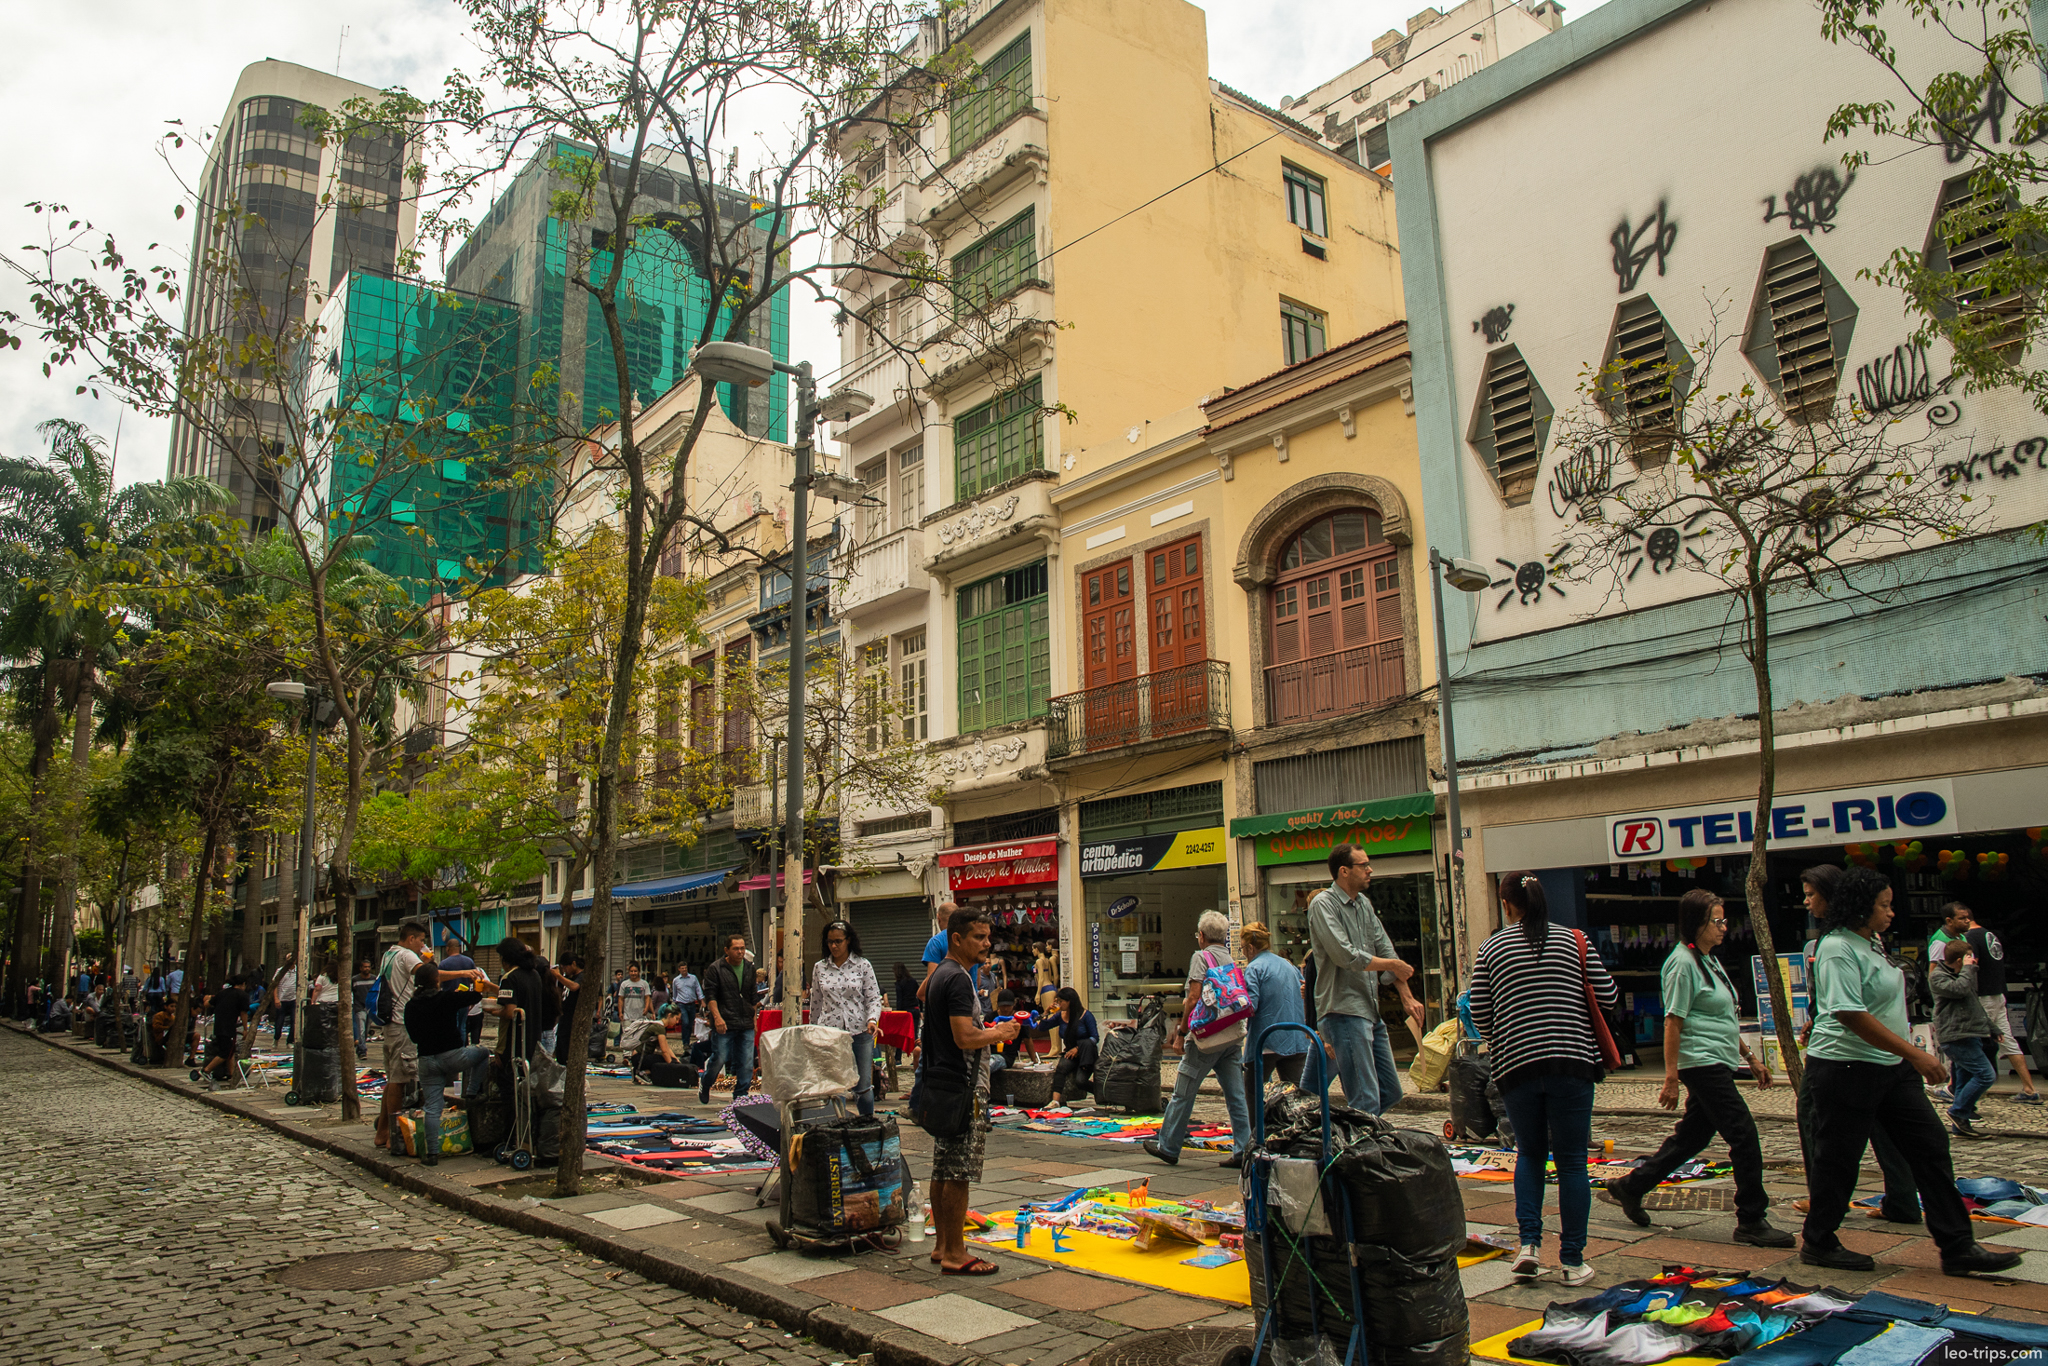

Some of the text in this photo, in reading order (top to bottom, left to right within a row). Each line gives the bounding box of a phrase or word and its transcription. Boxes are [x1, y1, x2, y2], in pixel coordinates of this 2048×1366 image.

[1287, 807, 1366, 828] quality shoes
[1668, 791, 1947, 849] TELE-RIO
[1185, 842, 1215, 855] 2242-4257
[1270, 821, 1413, 857] quality shoes
[964, 848, 1023, 862] Desejo de Mulher
[1083, 844, 1116, 859] centro
[965, 858, 1051, 883] Desejo de Mulher
[1081, 853, 1143, 872] ortopédico
[829, 1155, 843, 1227] EVERBEST
